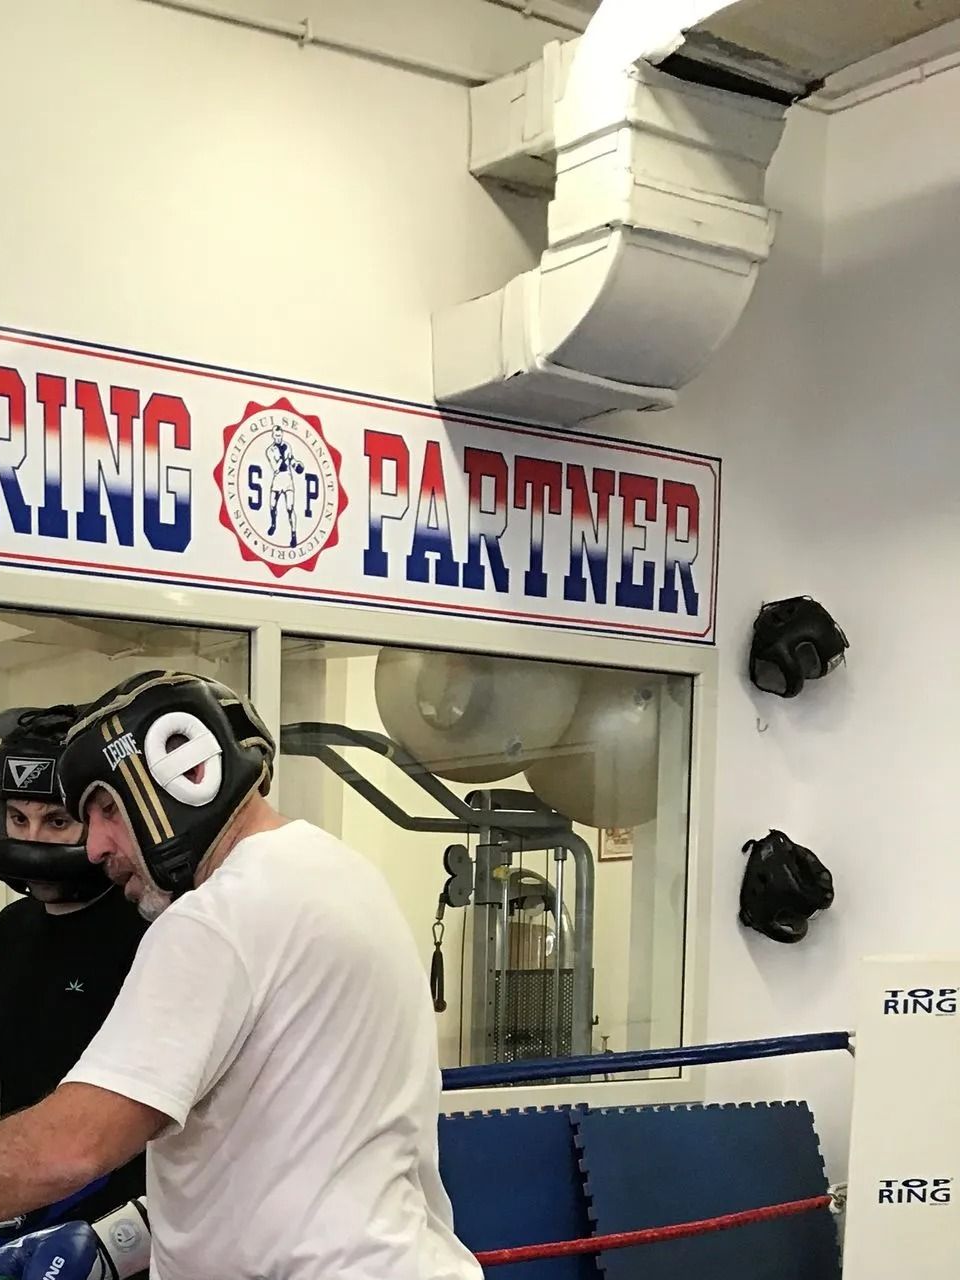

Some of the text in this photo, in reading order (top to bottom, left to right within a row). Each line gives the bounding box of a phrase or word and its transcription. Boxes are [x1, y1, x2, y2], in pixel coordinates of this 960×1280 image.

[228, 415, 335, 561] BIS VINCIT QUI SE VINCIT IN VICTORIA
[248, 464, 319, 518] S P
[363, 429, 701, 617] PARTNER
[102, 732, 143, 772] LEONE
[884, 998, 957, 1015] RING
[885, 988, 958, 999] TOP
[878, 1187, 951, 1204] RING
[879, 1178, 951, 1188] TOP
